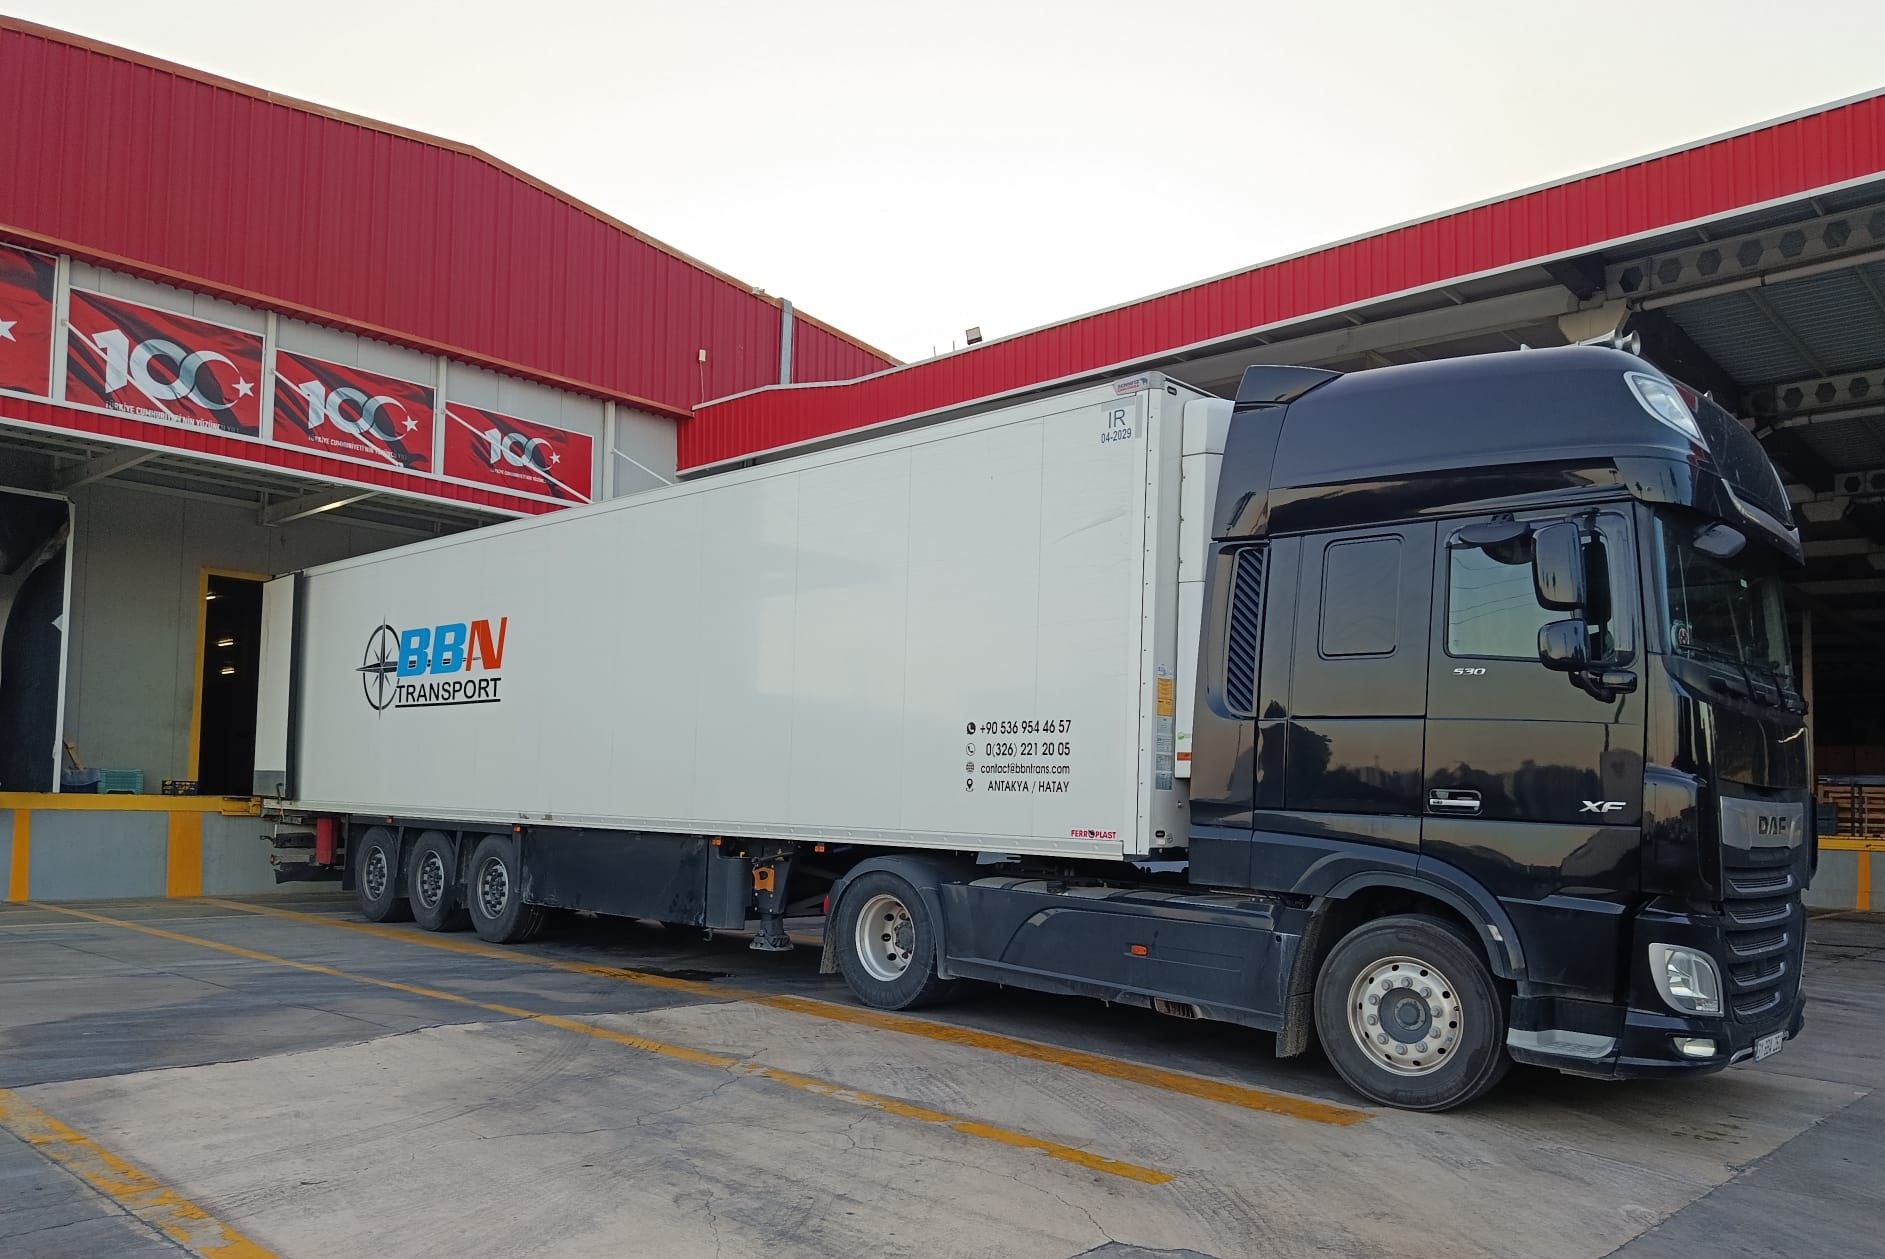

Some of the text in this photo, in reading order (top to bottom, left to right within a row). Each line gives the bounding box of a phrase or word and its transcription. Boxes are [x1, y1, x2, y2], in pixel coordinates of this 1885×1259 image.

[92, 329, 240, 410] 100
[299, 380, 407, 441] 100
[1108, 409, 1126, 428] IR
[1101, 427, 1132, 444] 04-2029
[397, 617, 508, 677] BBN
[1453, 667, 1486, 675] 530
[396, 678, 502, 703] TRANSPORT
[980, 719, 1071, 734] +90 536 954 46 57
[985, 742, 1070, 757] 0(326) 221 20 05
[980, 763, 1070, 774] contact@bbntrans.com
[988, 780, 1029, 792] ANTAKYA
[1038, 780, 1070, 793] HATAY
[1578, 800, 1627, 813] XF
[1758, 815, 1787, 836] DAF
